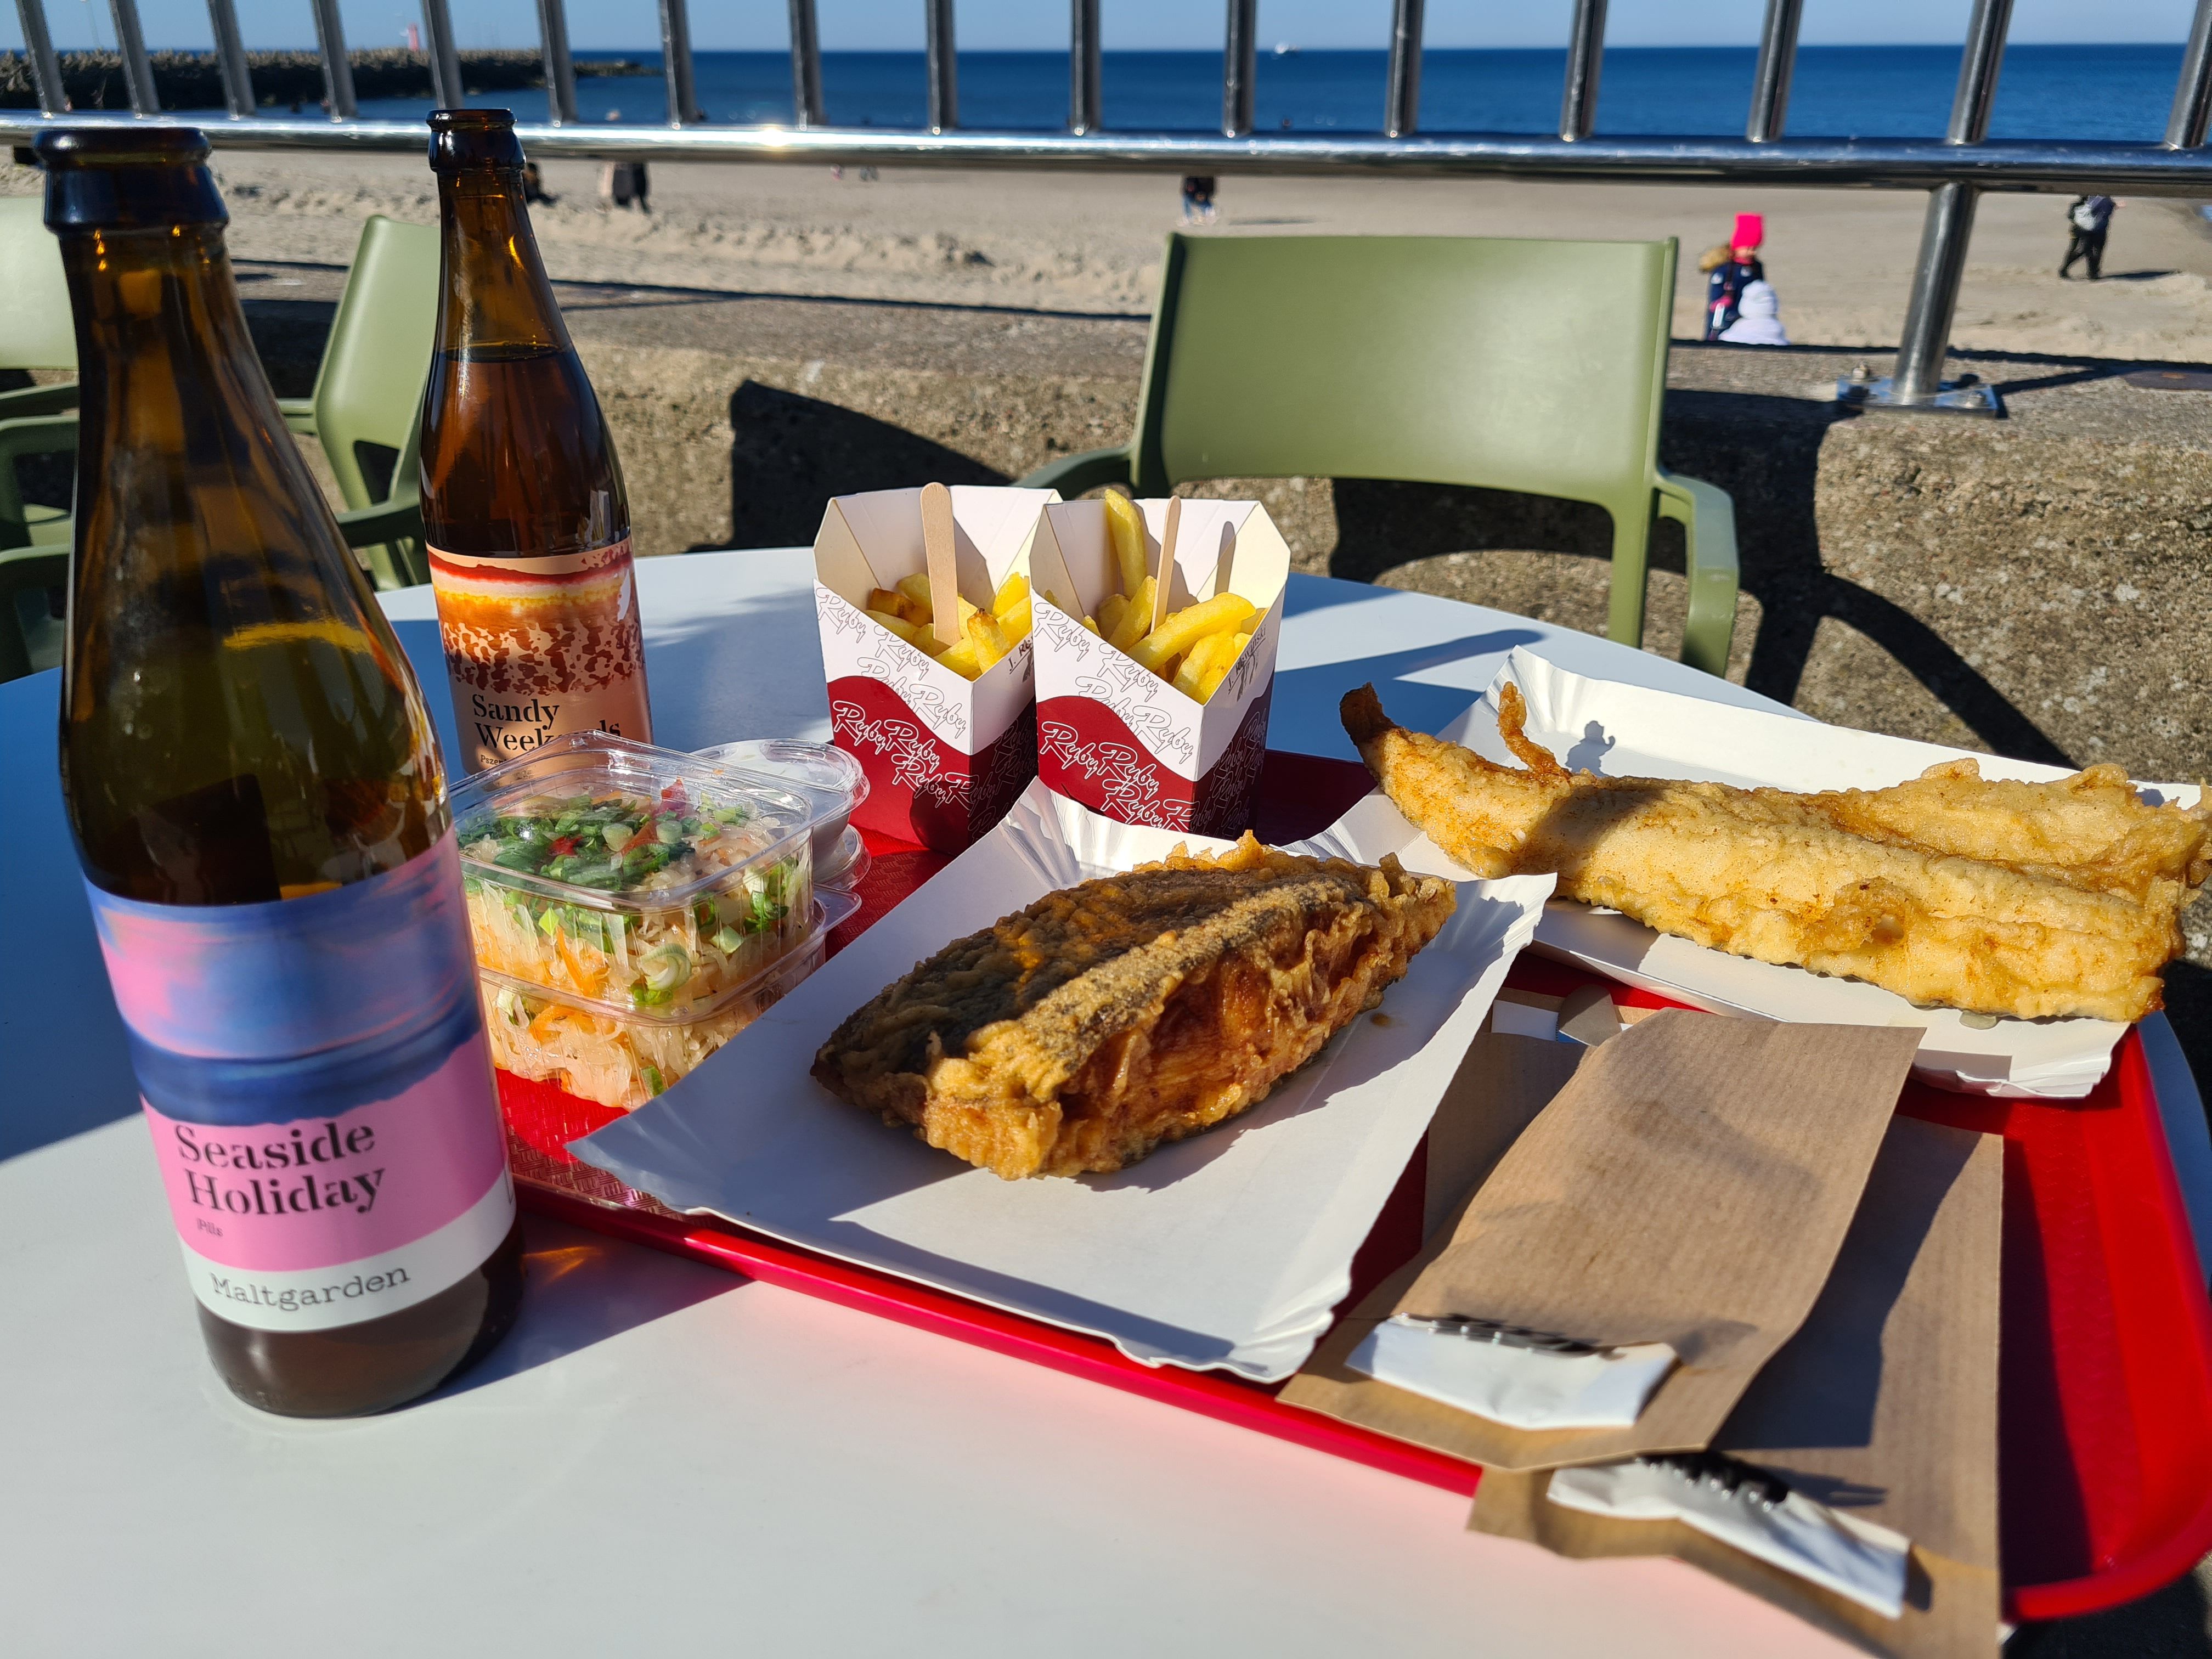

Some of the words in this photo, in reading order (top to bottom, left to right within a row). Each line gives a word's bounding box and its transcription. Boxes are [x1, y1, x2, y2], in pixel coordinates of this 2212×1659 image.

[816, 588, 866, 644] Ryby
[1034, 602, 1090, 662] Ryby
[472, 694, 560, 730] Sandy
[475, 720, 621, 751] Weekds
[833, 700, 887, 755] Ryby
[909, 684, 967, 739] Ryby
[1132, 706, 1194, 765] Ryby
[884, 719, 940, 774] Ryby
[1040, 721, 1097, 779] Ryby
[1098, 742, 1159, 799] Ryby
[891, 754, 946, 808] Ryby
[174, 1123, 375, 1169] Seaside
[184, 1168, 385, 1214] Holiday
[198, 1218, 223, 1237] Pils
[210, 1267, 411, 1312] Maltgarden
